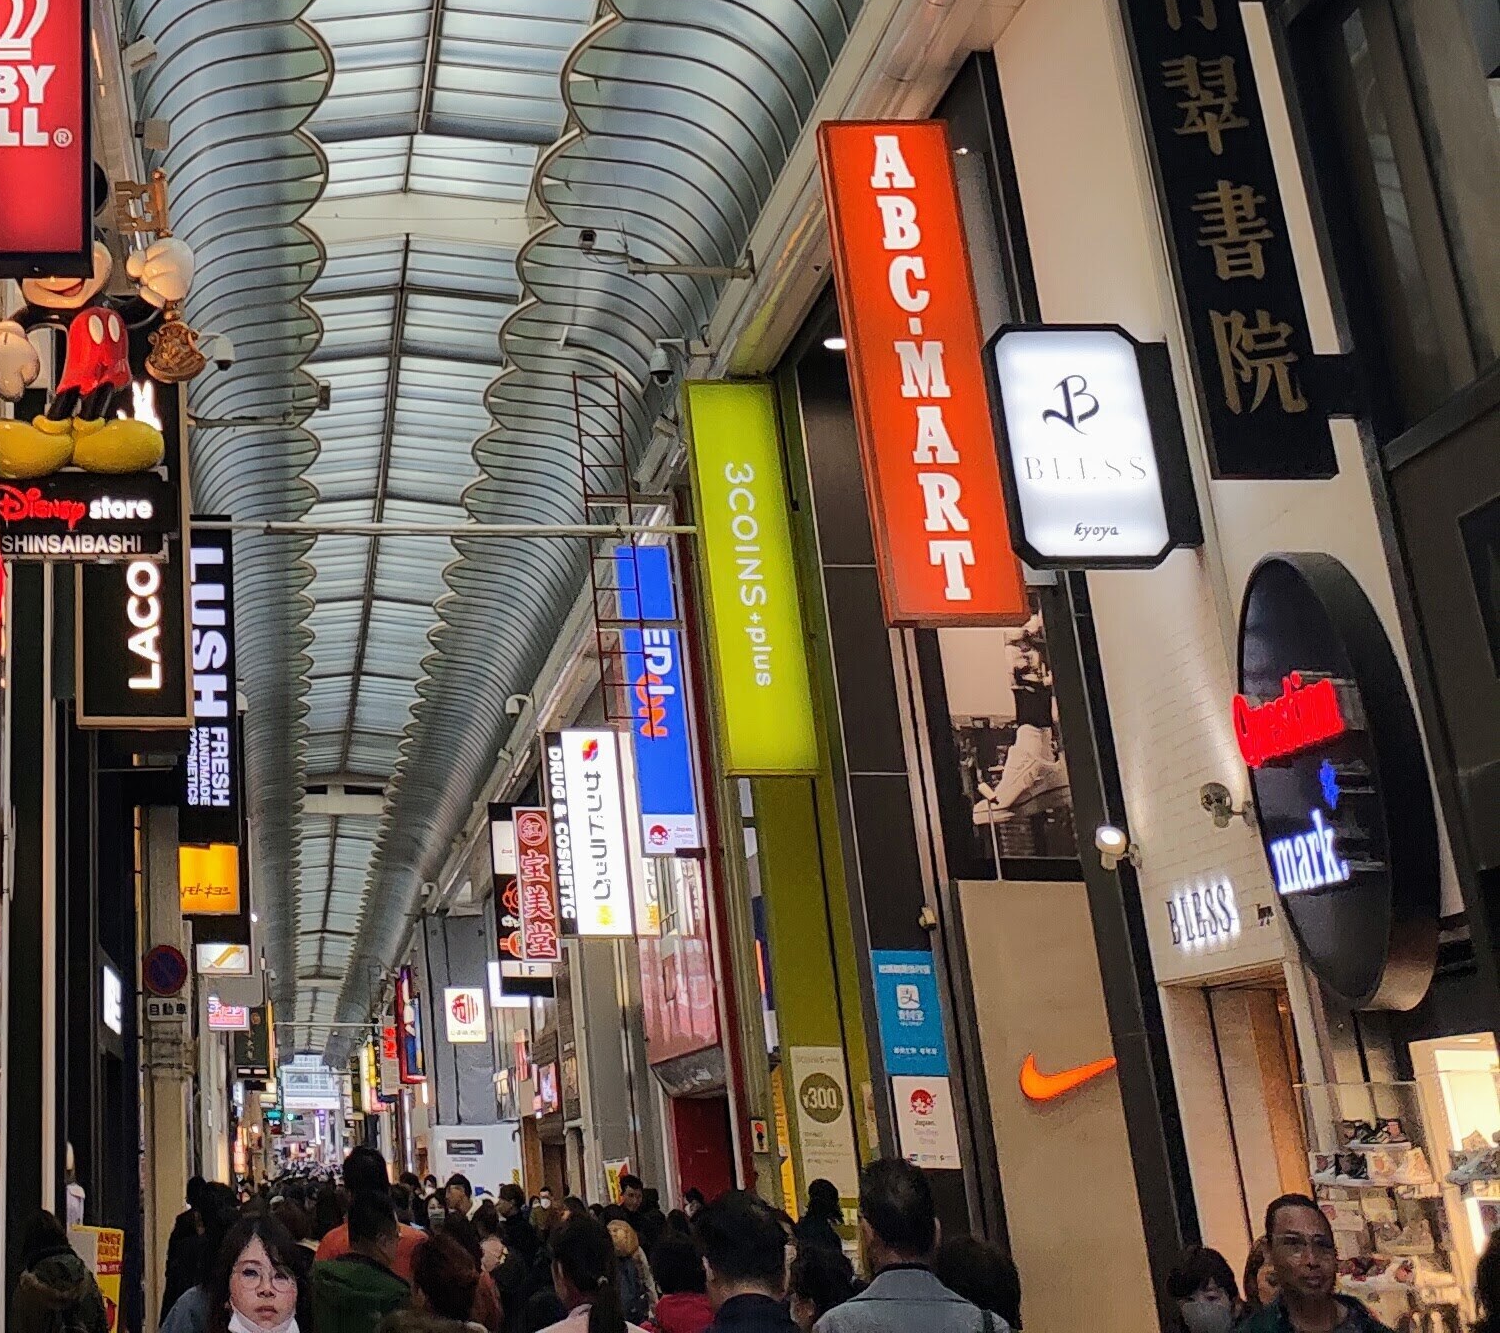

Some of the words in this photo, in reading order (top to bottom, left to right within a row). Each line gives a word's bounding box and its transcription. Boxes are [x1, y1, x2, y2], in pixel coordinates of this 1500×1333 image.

[870, 135, 975, 601] ABC-MART
[1, 534, 142, 554] SHINSAIBASHI
[89, 496, 153, 520] store
[1073, 522, 1119, 542] kyoya
[126, 561, 162, 690] LACO
[190, 547, 229, 718] LUSH
[187, 727, 199, 806] COSMETICS
[198, 727, 211, 807] HANDMADE
[211, 727, 231, 807] FRESH
[548, 746, 566, 801] DRUG
[555, 827, 577, 920] COSMETIC
[1166, 884, 1231, 945] BLESS
[149, 1002, 187, 1016] 自動車
